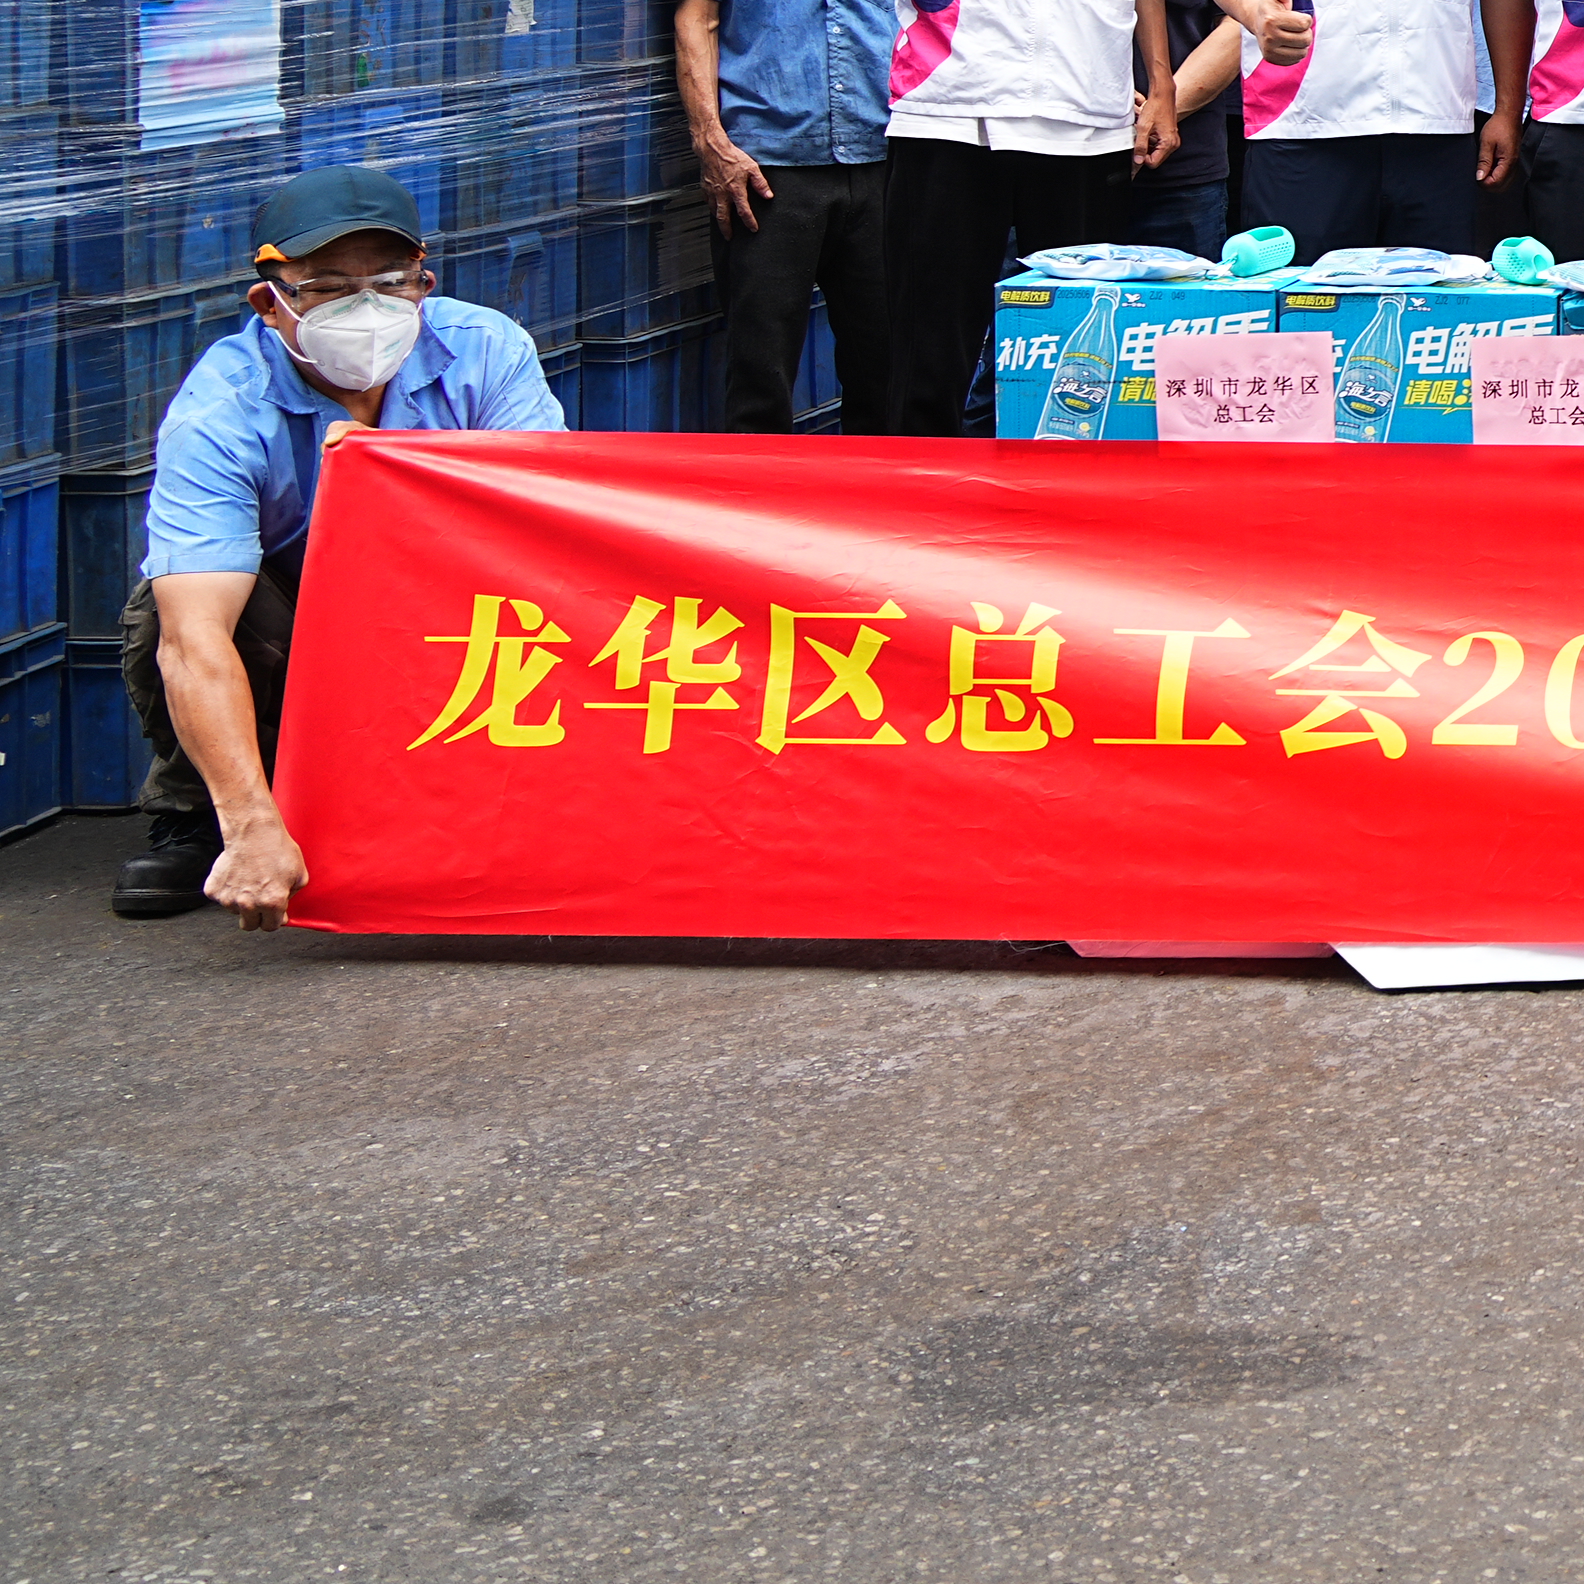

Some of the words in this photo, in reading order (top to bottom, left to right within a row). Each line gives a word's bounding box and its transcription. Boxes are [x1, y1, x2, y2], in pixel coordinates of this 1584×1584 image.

[1000, 290, 1050, 302] 电解质饮料
[1285, 295, 1336, 306] 电解质饮料
[996, 333, 1061, 372] 补充
[1165, 374, 1320, 399] 深圳市龙华区
[1338, 381, 1393, 407] 海之言
[1213, 403, 1276, 424] 总工会
